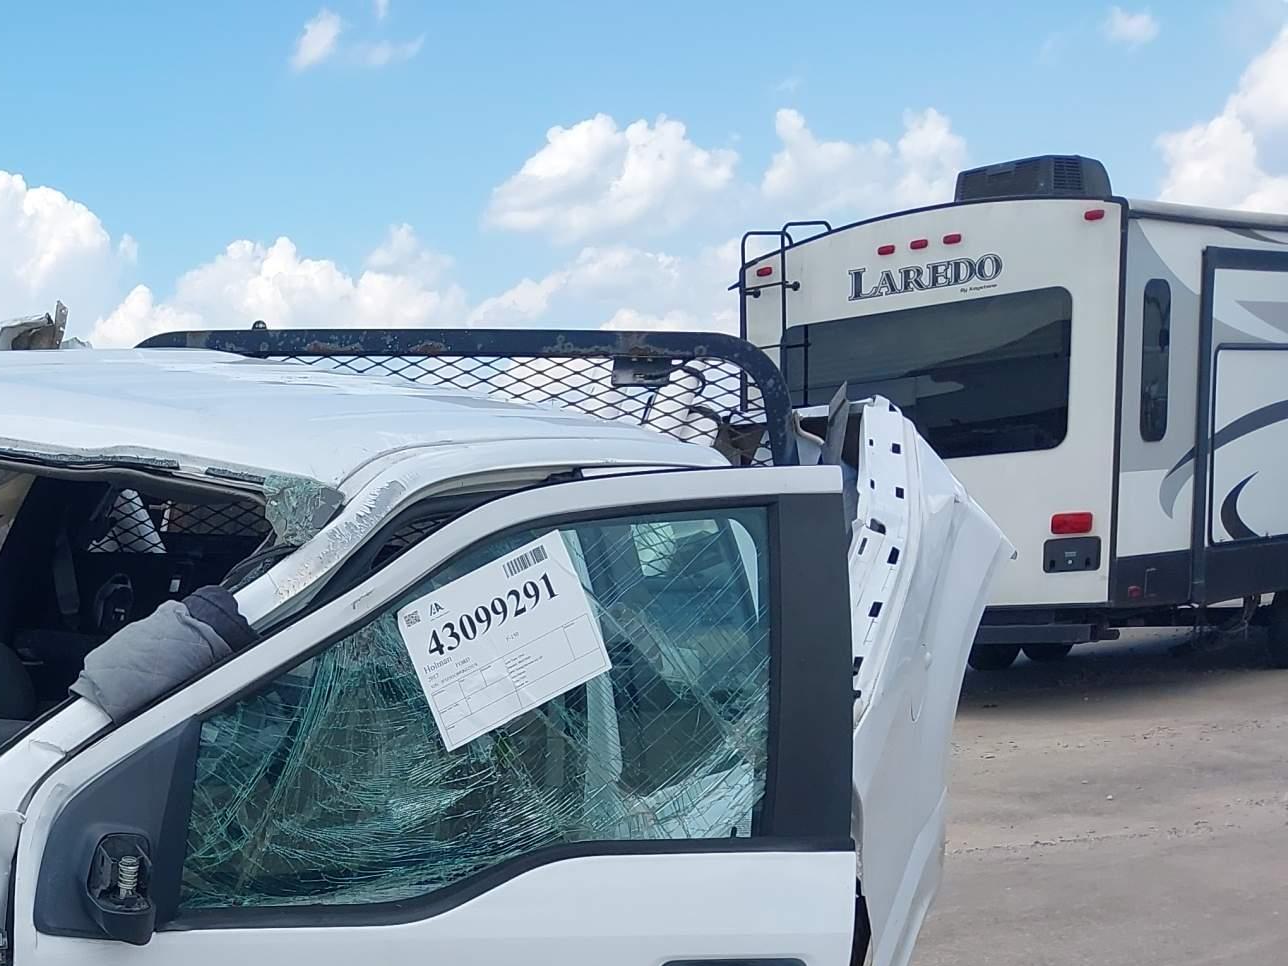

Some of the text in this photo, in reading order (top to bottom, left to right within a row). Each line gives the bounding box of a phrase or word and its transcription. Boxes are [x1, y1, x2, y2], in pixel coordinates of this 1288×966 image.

[848, 253, 1003, 301] LAREDO
[428, 571, 559, 656] 43099291
[423, 656, 453, 675] Holman
